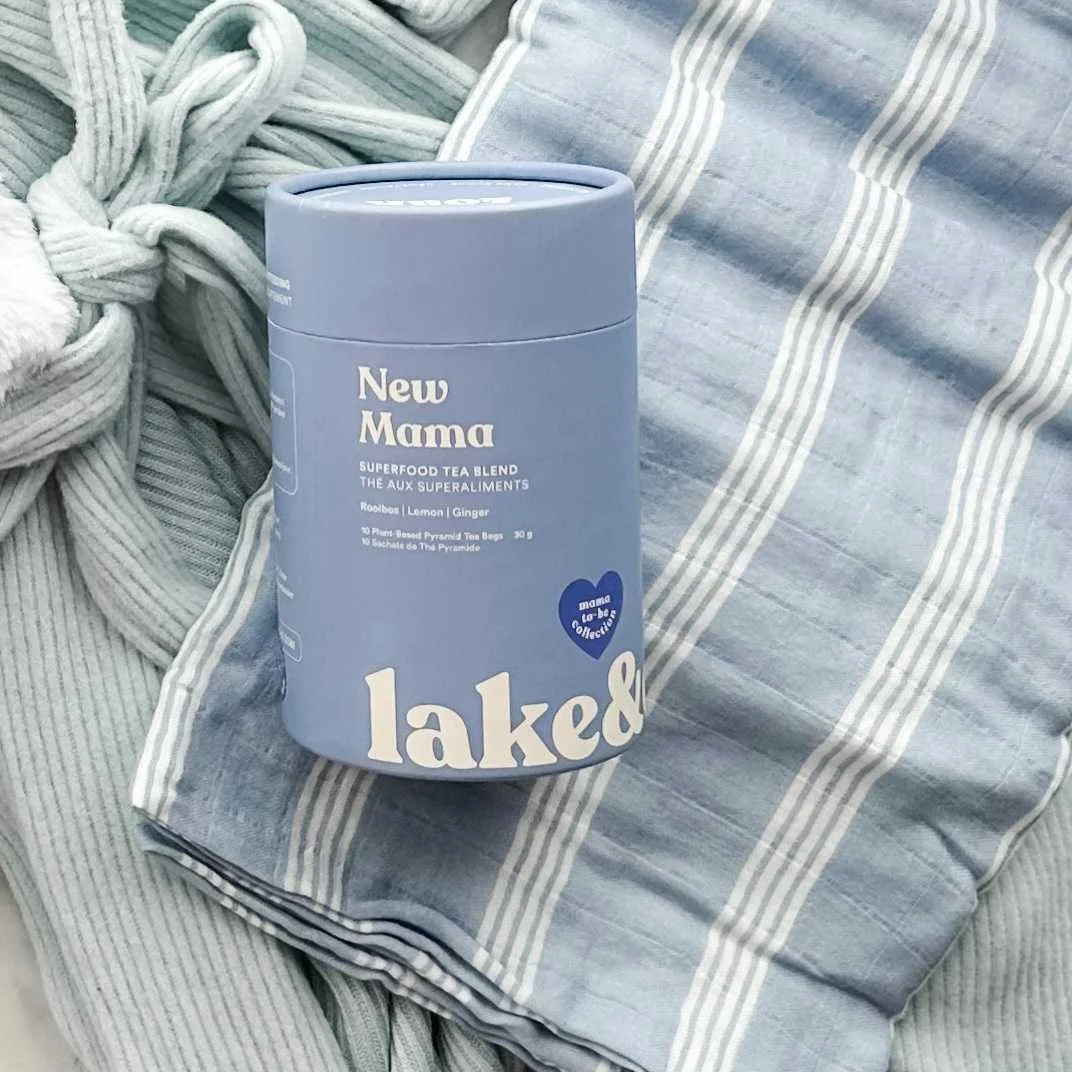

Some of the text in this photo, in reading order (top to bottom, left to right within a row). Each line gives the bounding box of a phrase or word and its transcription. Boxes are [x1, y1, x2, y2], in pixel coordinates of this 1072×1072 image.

[357, 365, 449, 404] New
[359, 410, 494, 448] Mama
[359, 460, 518, 477] SUPERFOOD TEA BLEND
[386, 480, 413, 490] AUX
[417, 479, 529, 493] SUPERALIMENTS
[360, 501, 399, 516] Rooibos
[407, 507, 444, 518] Lemon
[452, 507, 489, 520] Ginger
[424, 531, 461, 542] Pyramid
[463, 532, 480, 541] Tea
[482, 531, 504, 542] Bags
[514, 530, 525, 539] 30
[526, 530, 533, 540] g
[578, 594, 611, 611] mama
[581, 607, 609, 624] to-be
